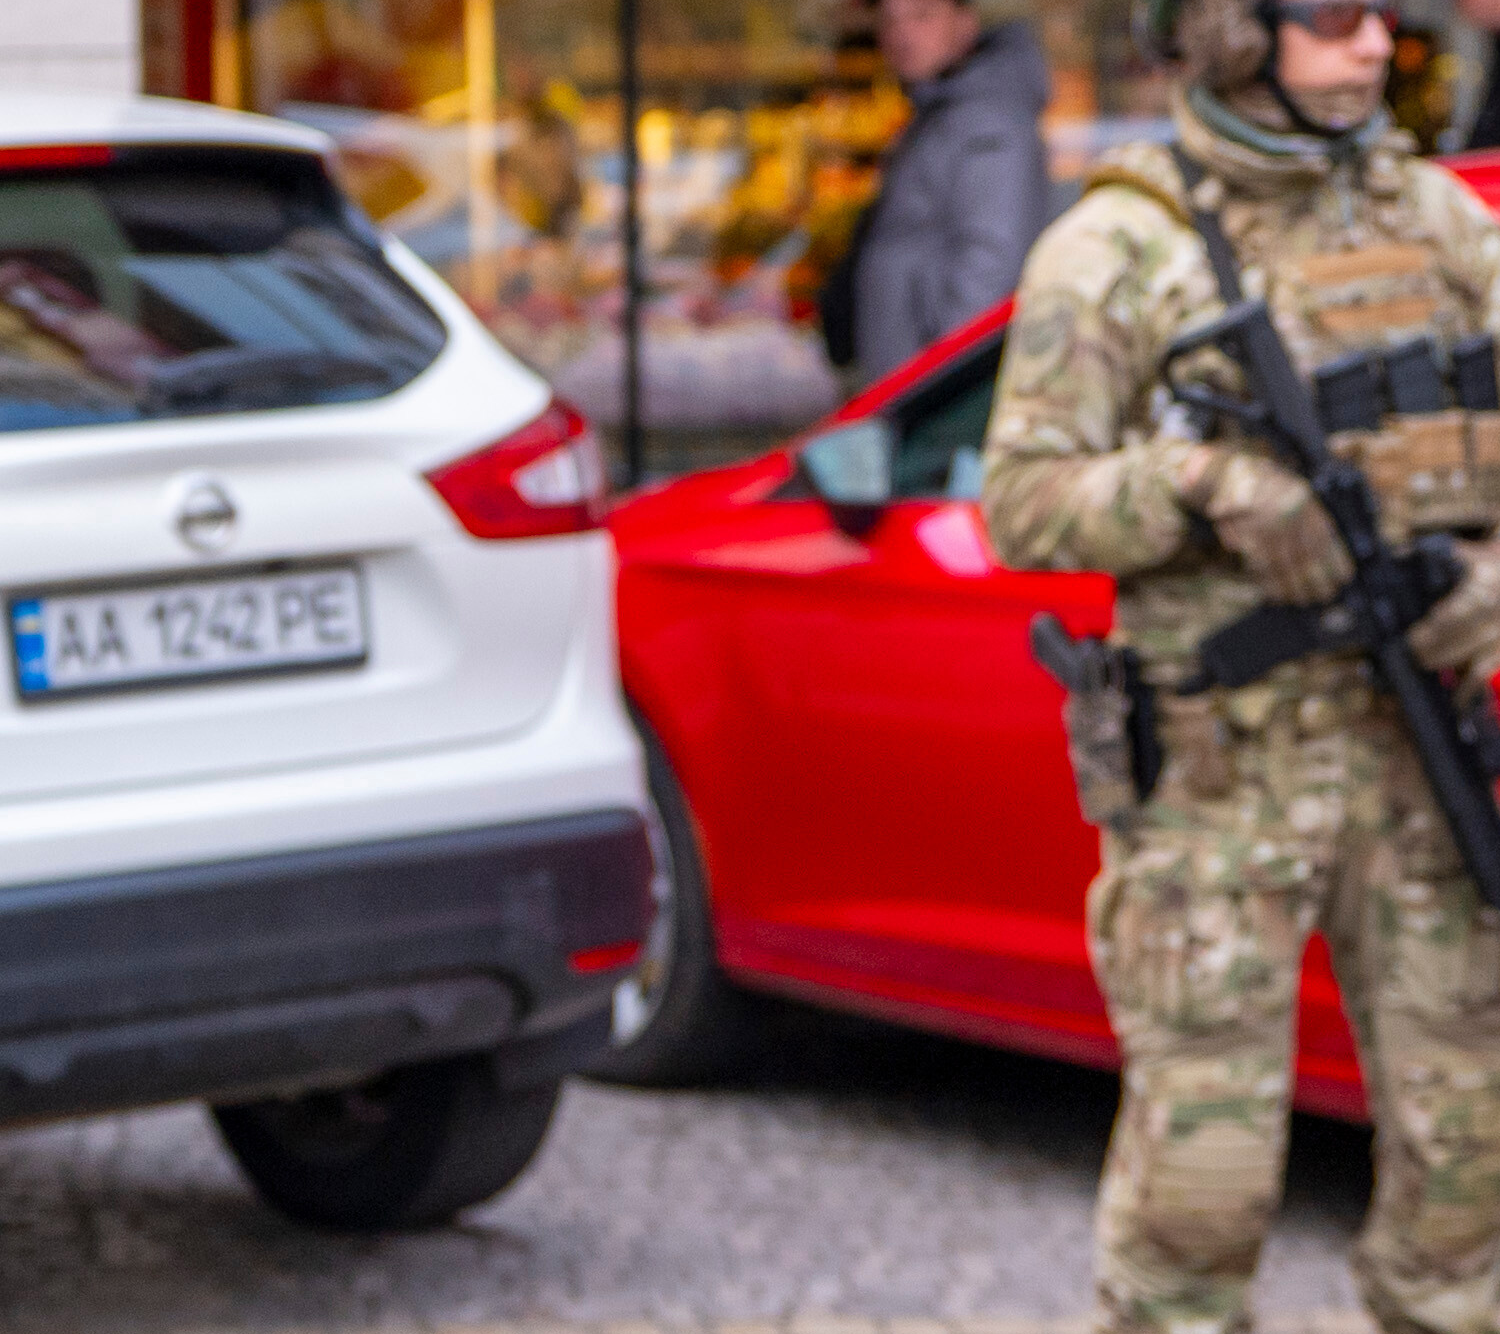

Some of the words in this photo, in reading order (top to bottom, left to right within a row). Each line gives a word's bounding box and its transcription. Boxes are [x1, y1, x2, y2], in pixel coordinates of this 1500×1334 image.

[57, 601, 133, 667] AA
[150, 583, 263, 659] 1242
[272, 574, 352, 645] PE
